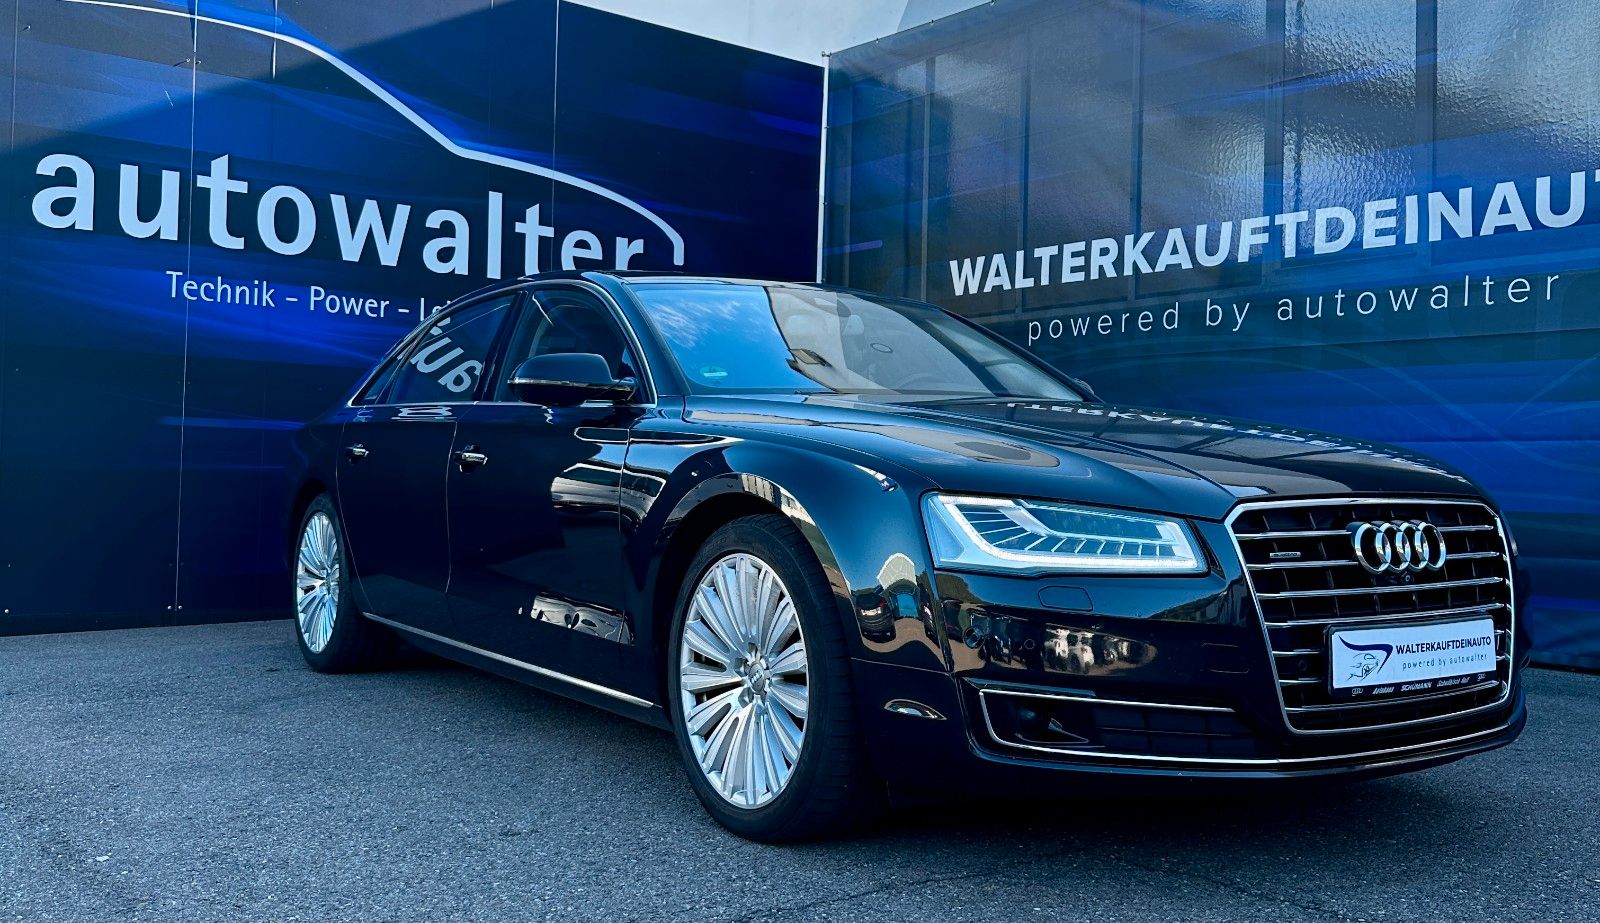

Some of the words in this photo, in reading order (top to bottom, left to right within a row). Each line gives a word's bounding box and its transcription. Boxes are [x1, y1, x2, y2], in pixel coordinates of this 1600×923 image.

[32, 153, 645, 280] autowalter
[949, 169, 1600, 296] WALTERKAUFTDEINAU
[166, 270, 276, 307] Technik
[309, 285, 390, 318] Power
[1028, 302, 1180, 346] powered
[1206, 299, 1251, 332] by
[1276, 271, 1560, 321] autowalter
[1395, 635, 1492, 655] WALTERKAUFTDEINAUTO
[1402, 657, 1435, 671] powered
[1438, 658, 1447, 667] by
[1449, 653, 1487, 665] autowalter
